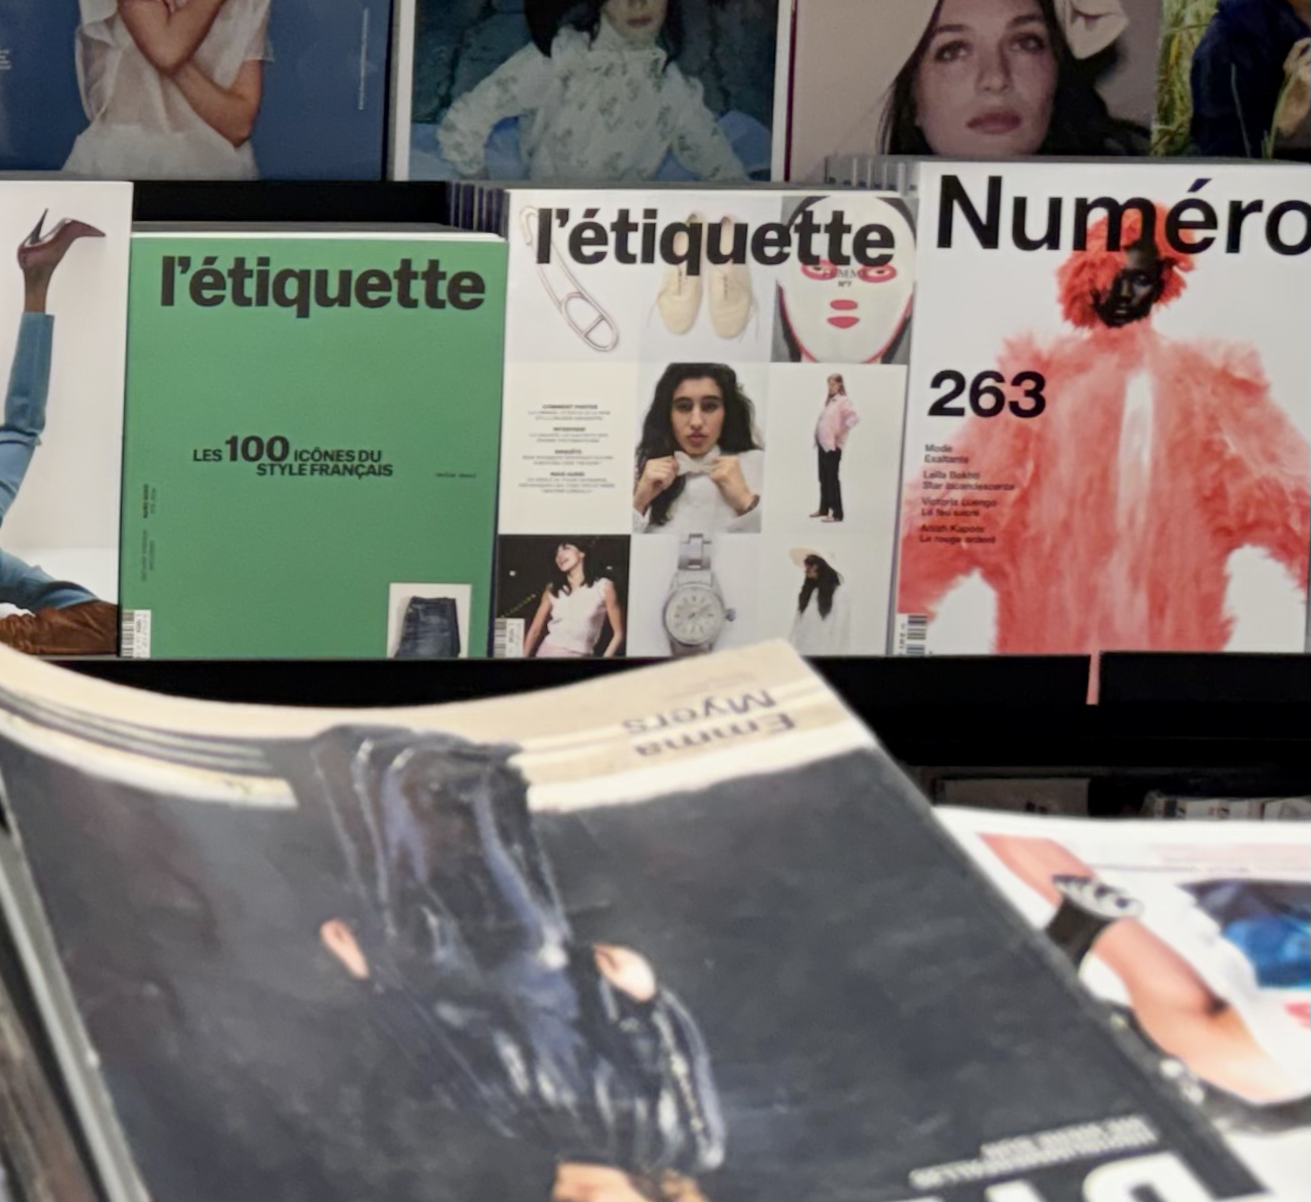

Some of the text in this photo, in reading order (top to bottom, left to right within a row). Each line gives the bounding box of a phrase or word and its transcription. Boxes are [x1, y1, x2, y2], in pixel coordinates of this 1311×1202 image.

[936, 174, 1311, 256] Numéro
[928, 369, 1047, 419] 263
[193, 435, 382, 462] LES 100 ICÔNES DU
[924, 444, 953, 453] Mode
[256, 463, 394, 480] STYLE FRANÇAIS
[635, 712, 796, 757] Emma
